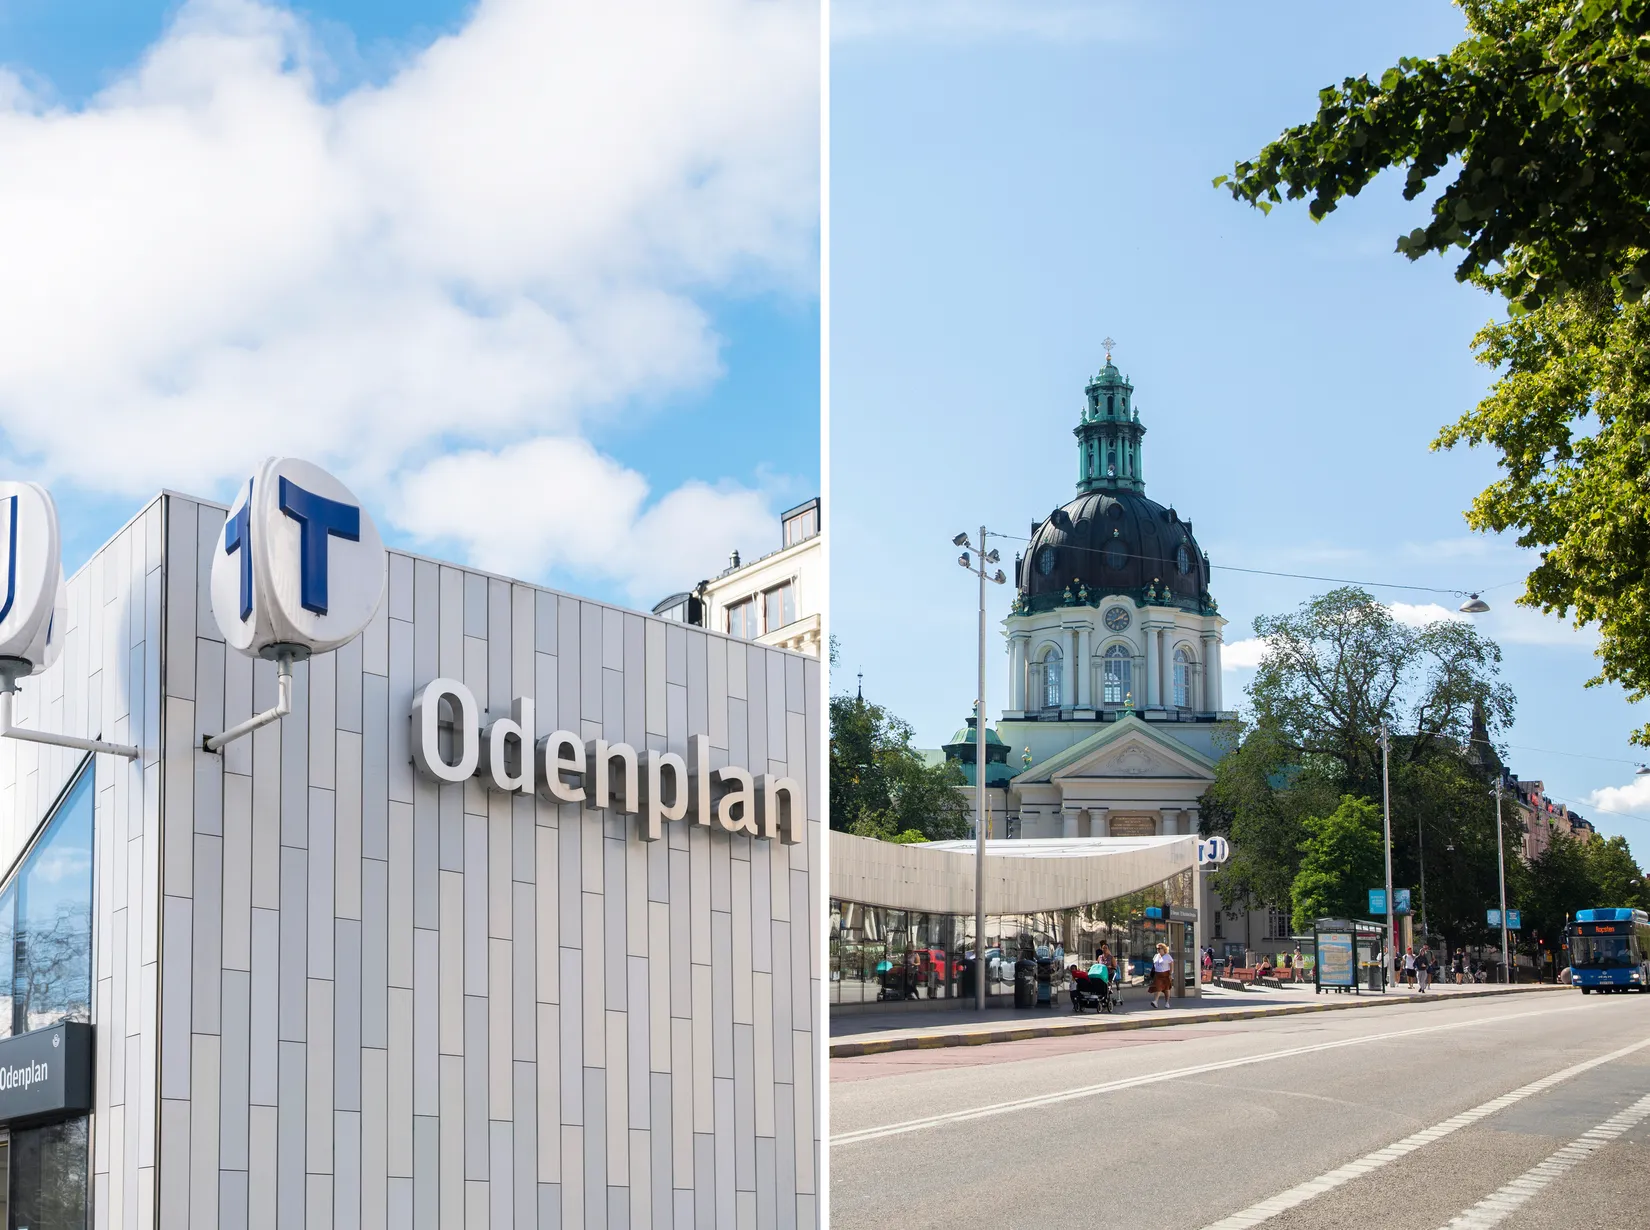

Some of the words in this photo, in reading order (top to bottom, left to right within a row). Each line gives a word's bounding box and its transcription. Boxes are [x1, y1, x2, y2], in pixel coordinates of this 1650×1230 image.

[279, 475, 360, 616] T
[411, 677, 803, 845] Odenplan
[1208, 840, 1217, 860] J
[1578, 926, 1583, 935] 6
[0, 1059, 48, 1091] Odenplan
